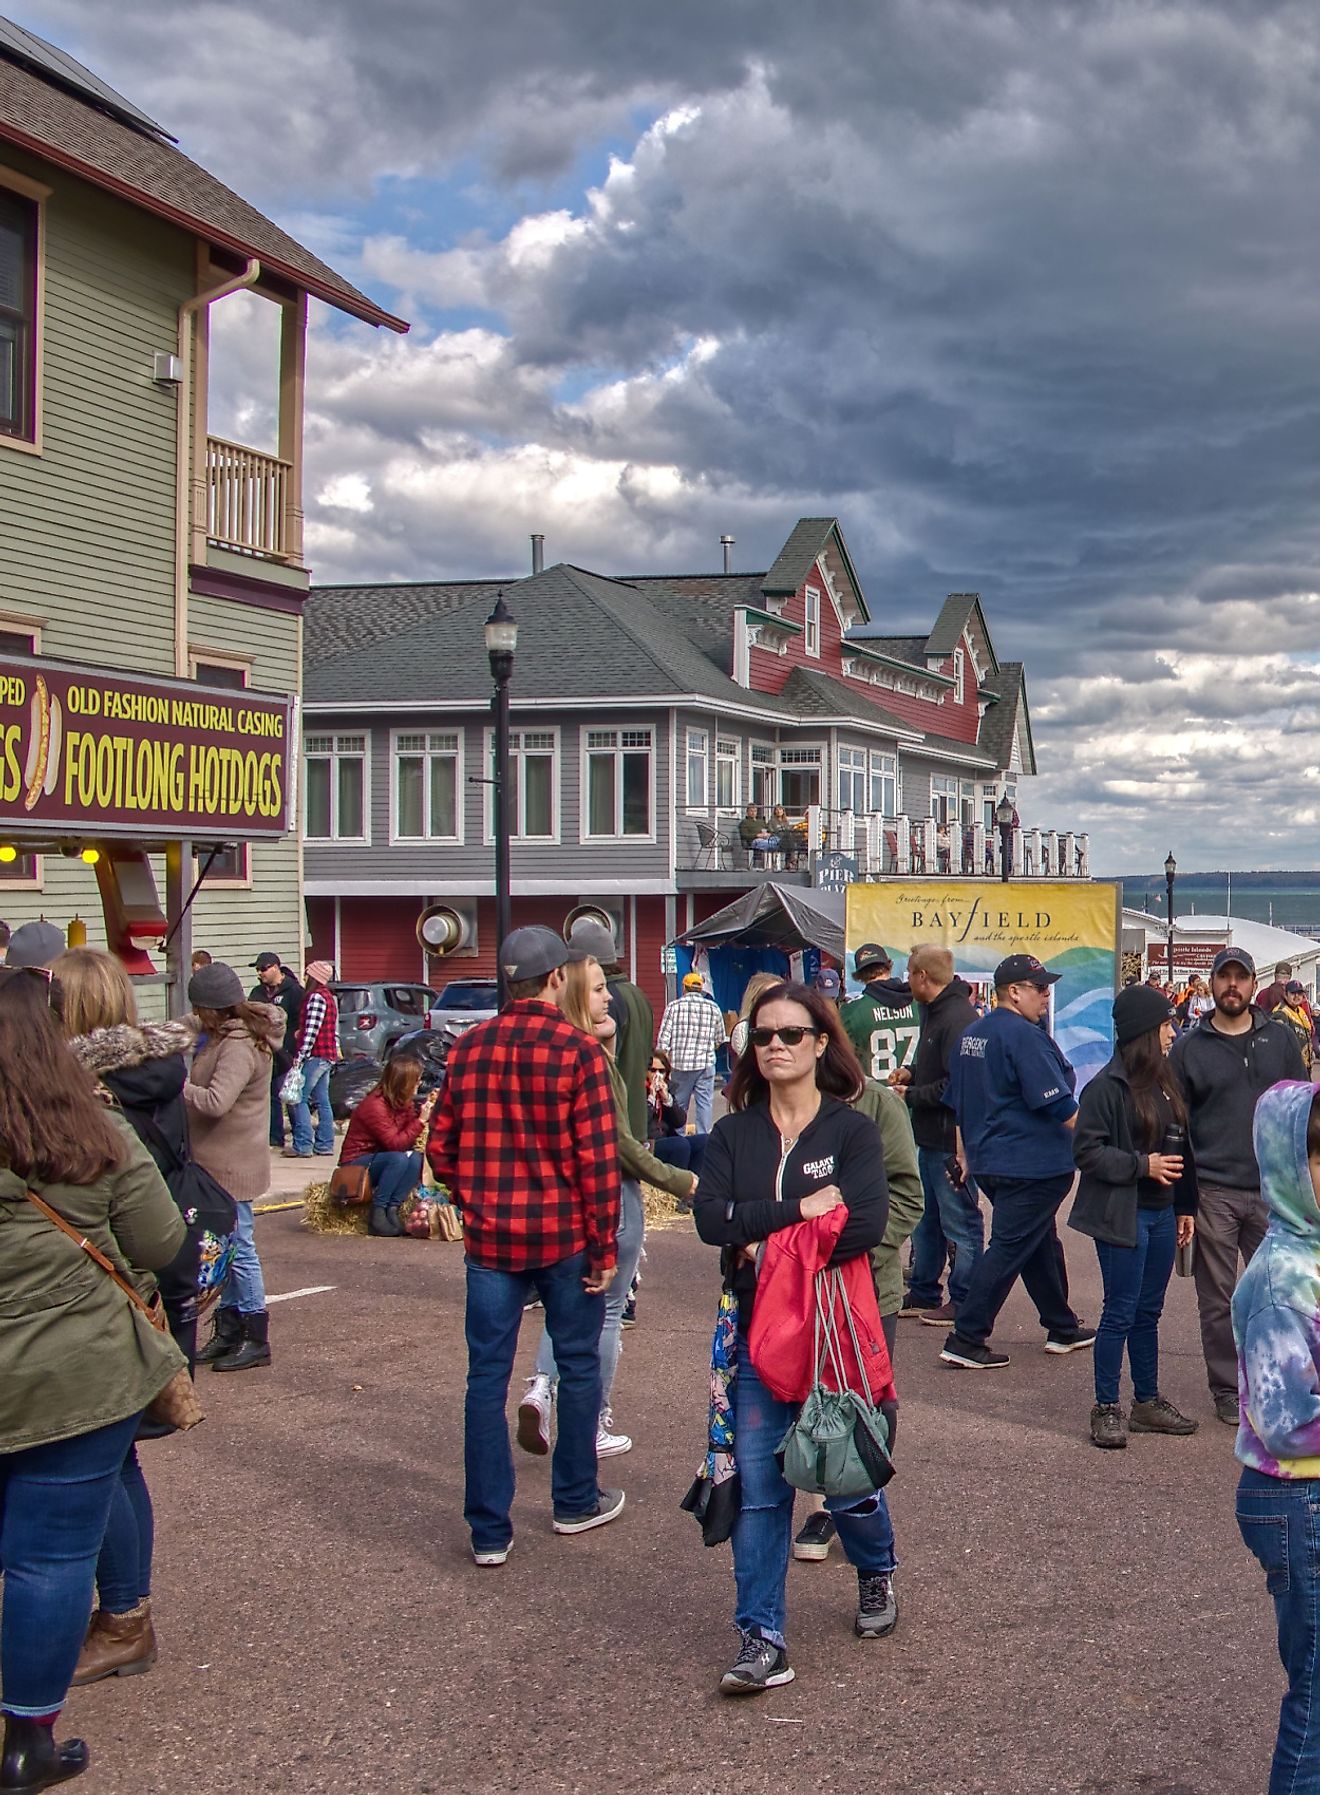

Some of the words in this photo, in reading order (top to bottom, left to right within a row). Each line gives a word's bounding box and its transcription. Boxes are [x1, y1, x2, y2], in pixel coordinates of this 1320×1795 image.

[67, 685, 100, 715] OLD
[104, 691, 169, 724] FASHION
[172, 701, 235, 733] NATURAL
[237, 709, 283, 738] CASING
[65, 731, 184, 811] FOOTLONG
[189, 744, 282, 818] HOTDOGS
[819, 868, 854, 885] PIER
[872, 1006, 914, 1022] NELSON
[870, 1026, 921, 1080] 87
[1044, 1087, 1060, 1099] EMS
[803, 1156, 834, 1175] GALAXY
[811, 1165, 834, 1179] TACO
